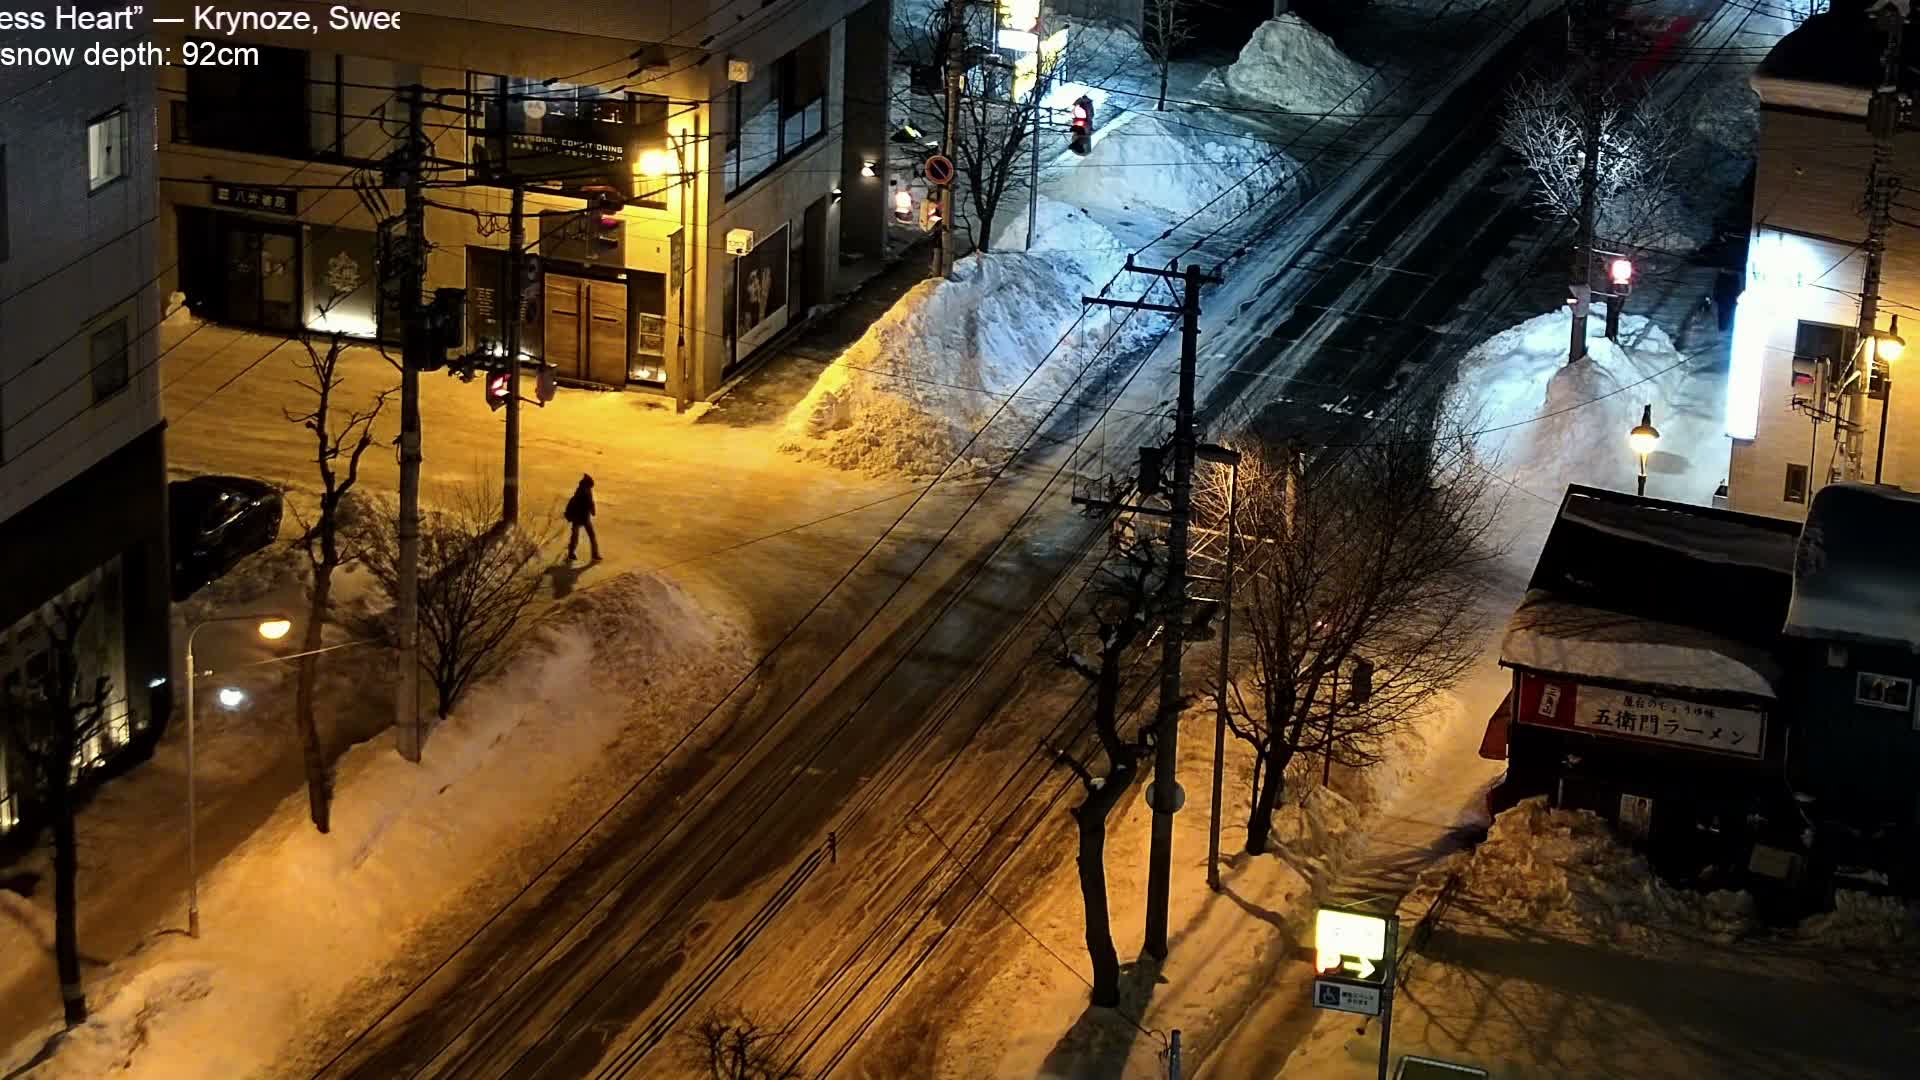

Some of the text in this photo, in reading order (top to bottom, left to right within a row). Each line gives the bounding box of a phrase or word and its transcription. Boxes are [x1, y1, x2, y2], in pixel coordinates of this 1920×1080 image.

[1591, 708, 1746, 745] 五衛門ラーメン
